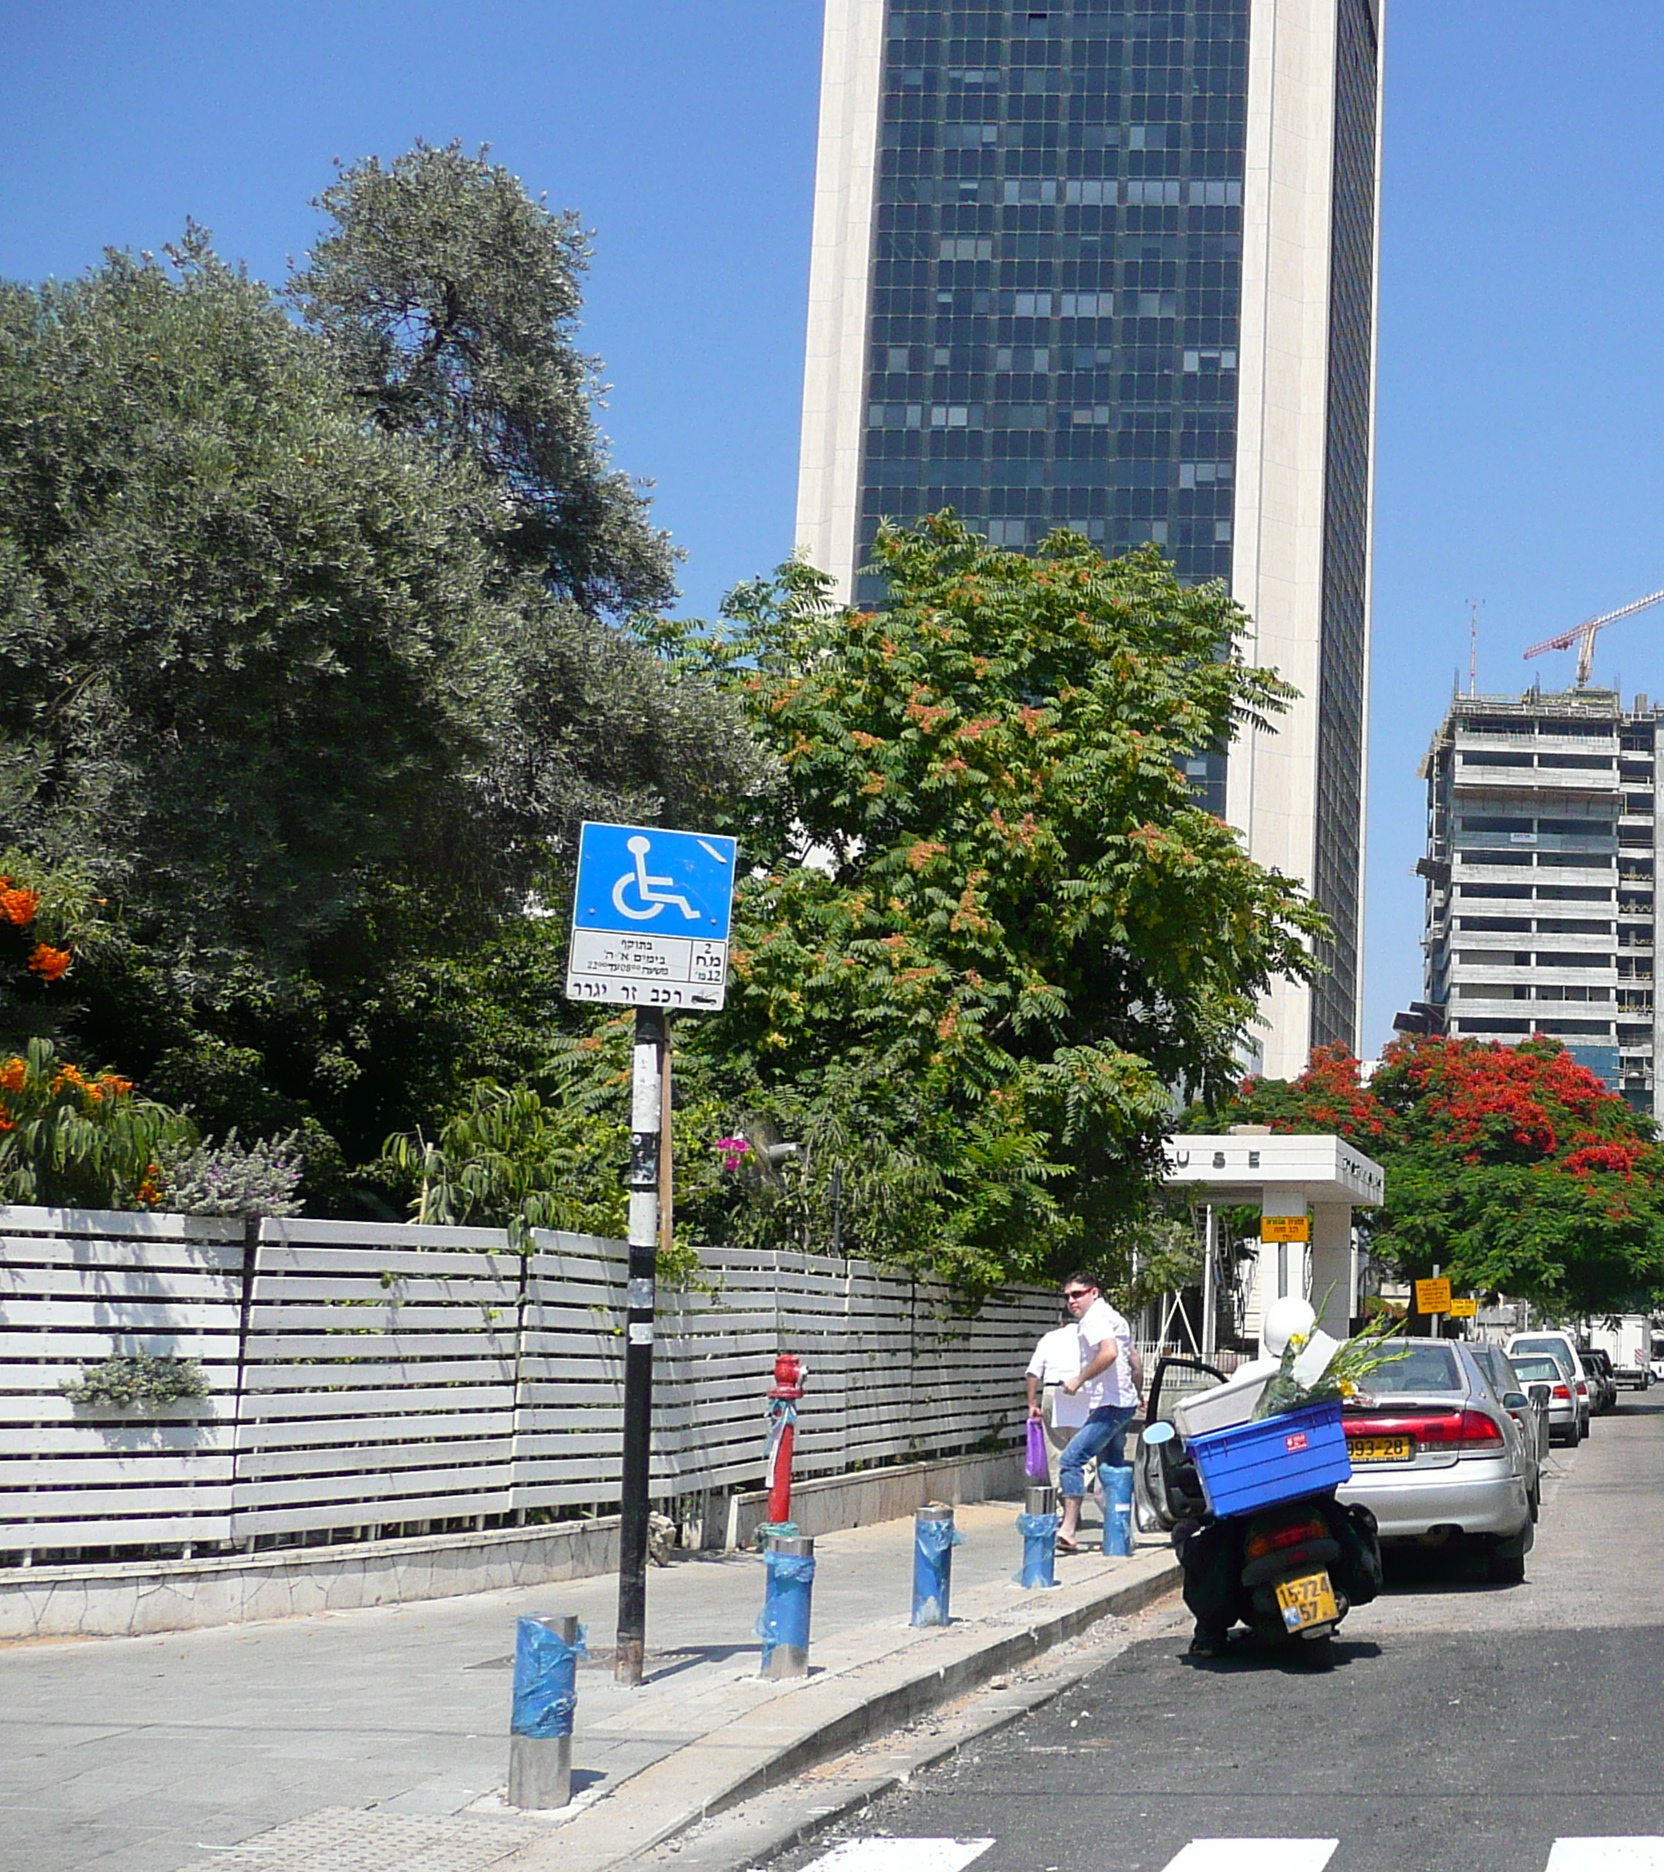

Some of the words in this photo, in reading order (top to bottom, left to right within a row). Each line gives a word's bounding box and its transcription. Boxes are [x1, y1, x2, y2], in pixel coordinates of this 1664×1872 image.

[621, 939, 653, 951] בתוקף
[704, 943, 712, 954] 2
[634, 954, 666, 965] בימים
[573, 982, 607, 999] יגרר
[620, 984, 638, 1001] זר
[650, 988, 683, 1004] רכב
[1299, 1601, 1318, 1621] 57
